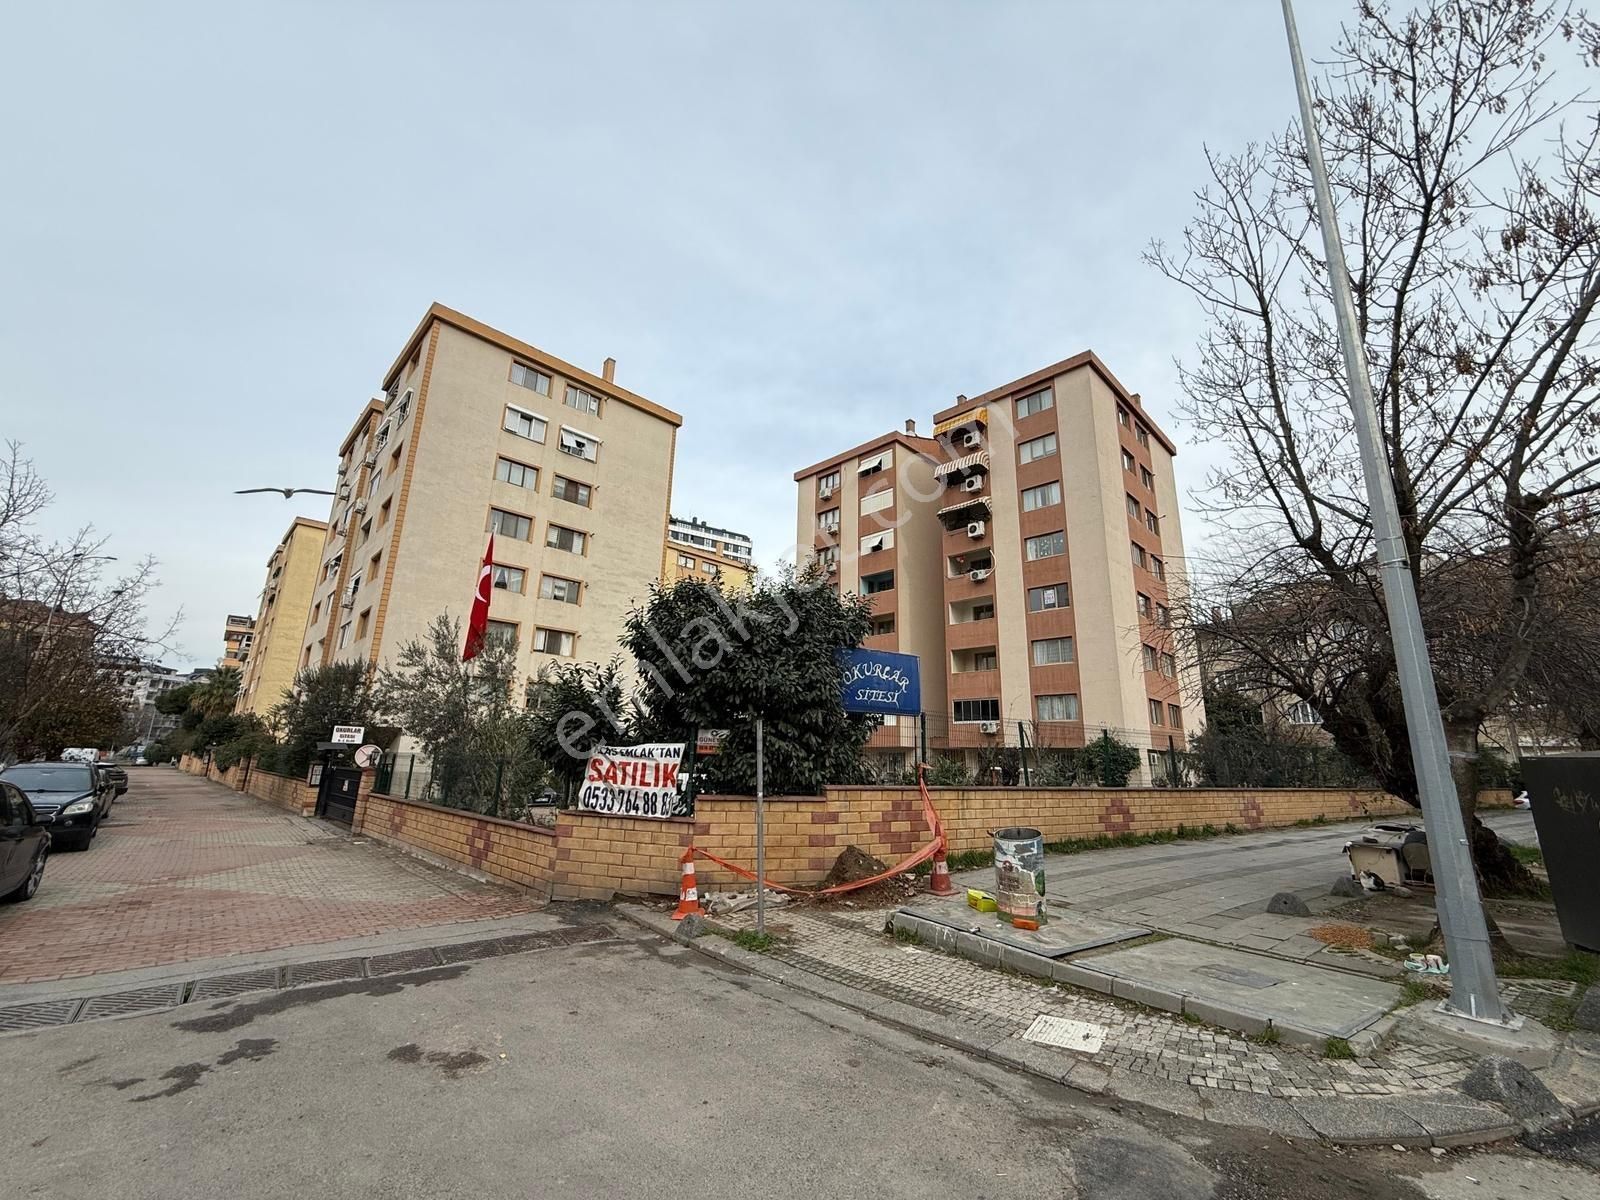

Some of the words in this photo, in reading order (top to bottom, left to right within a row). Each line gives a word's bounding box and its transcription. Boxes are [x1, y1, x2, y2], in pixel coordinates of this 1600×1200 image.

[843, 661, 910, 694] OKURLAR
[588, 758, 679, 787] SATILIK
[583, 786, 615, 812] 0533
[617, 789, 640, 814] 764
[643, 791, 658, 815] 88
